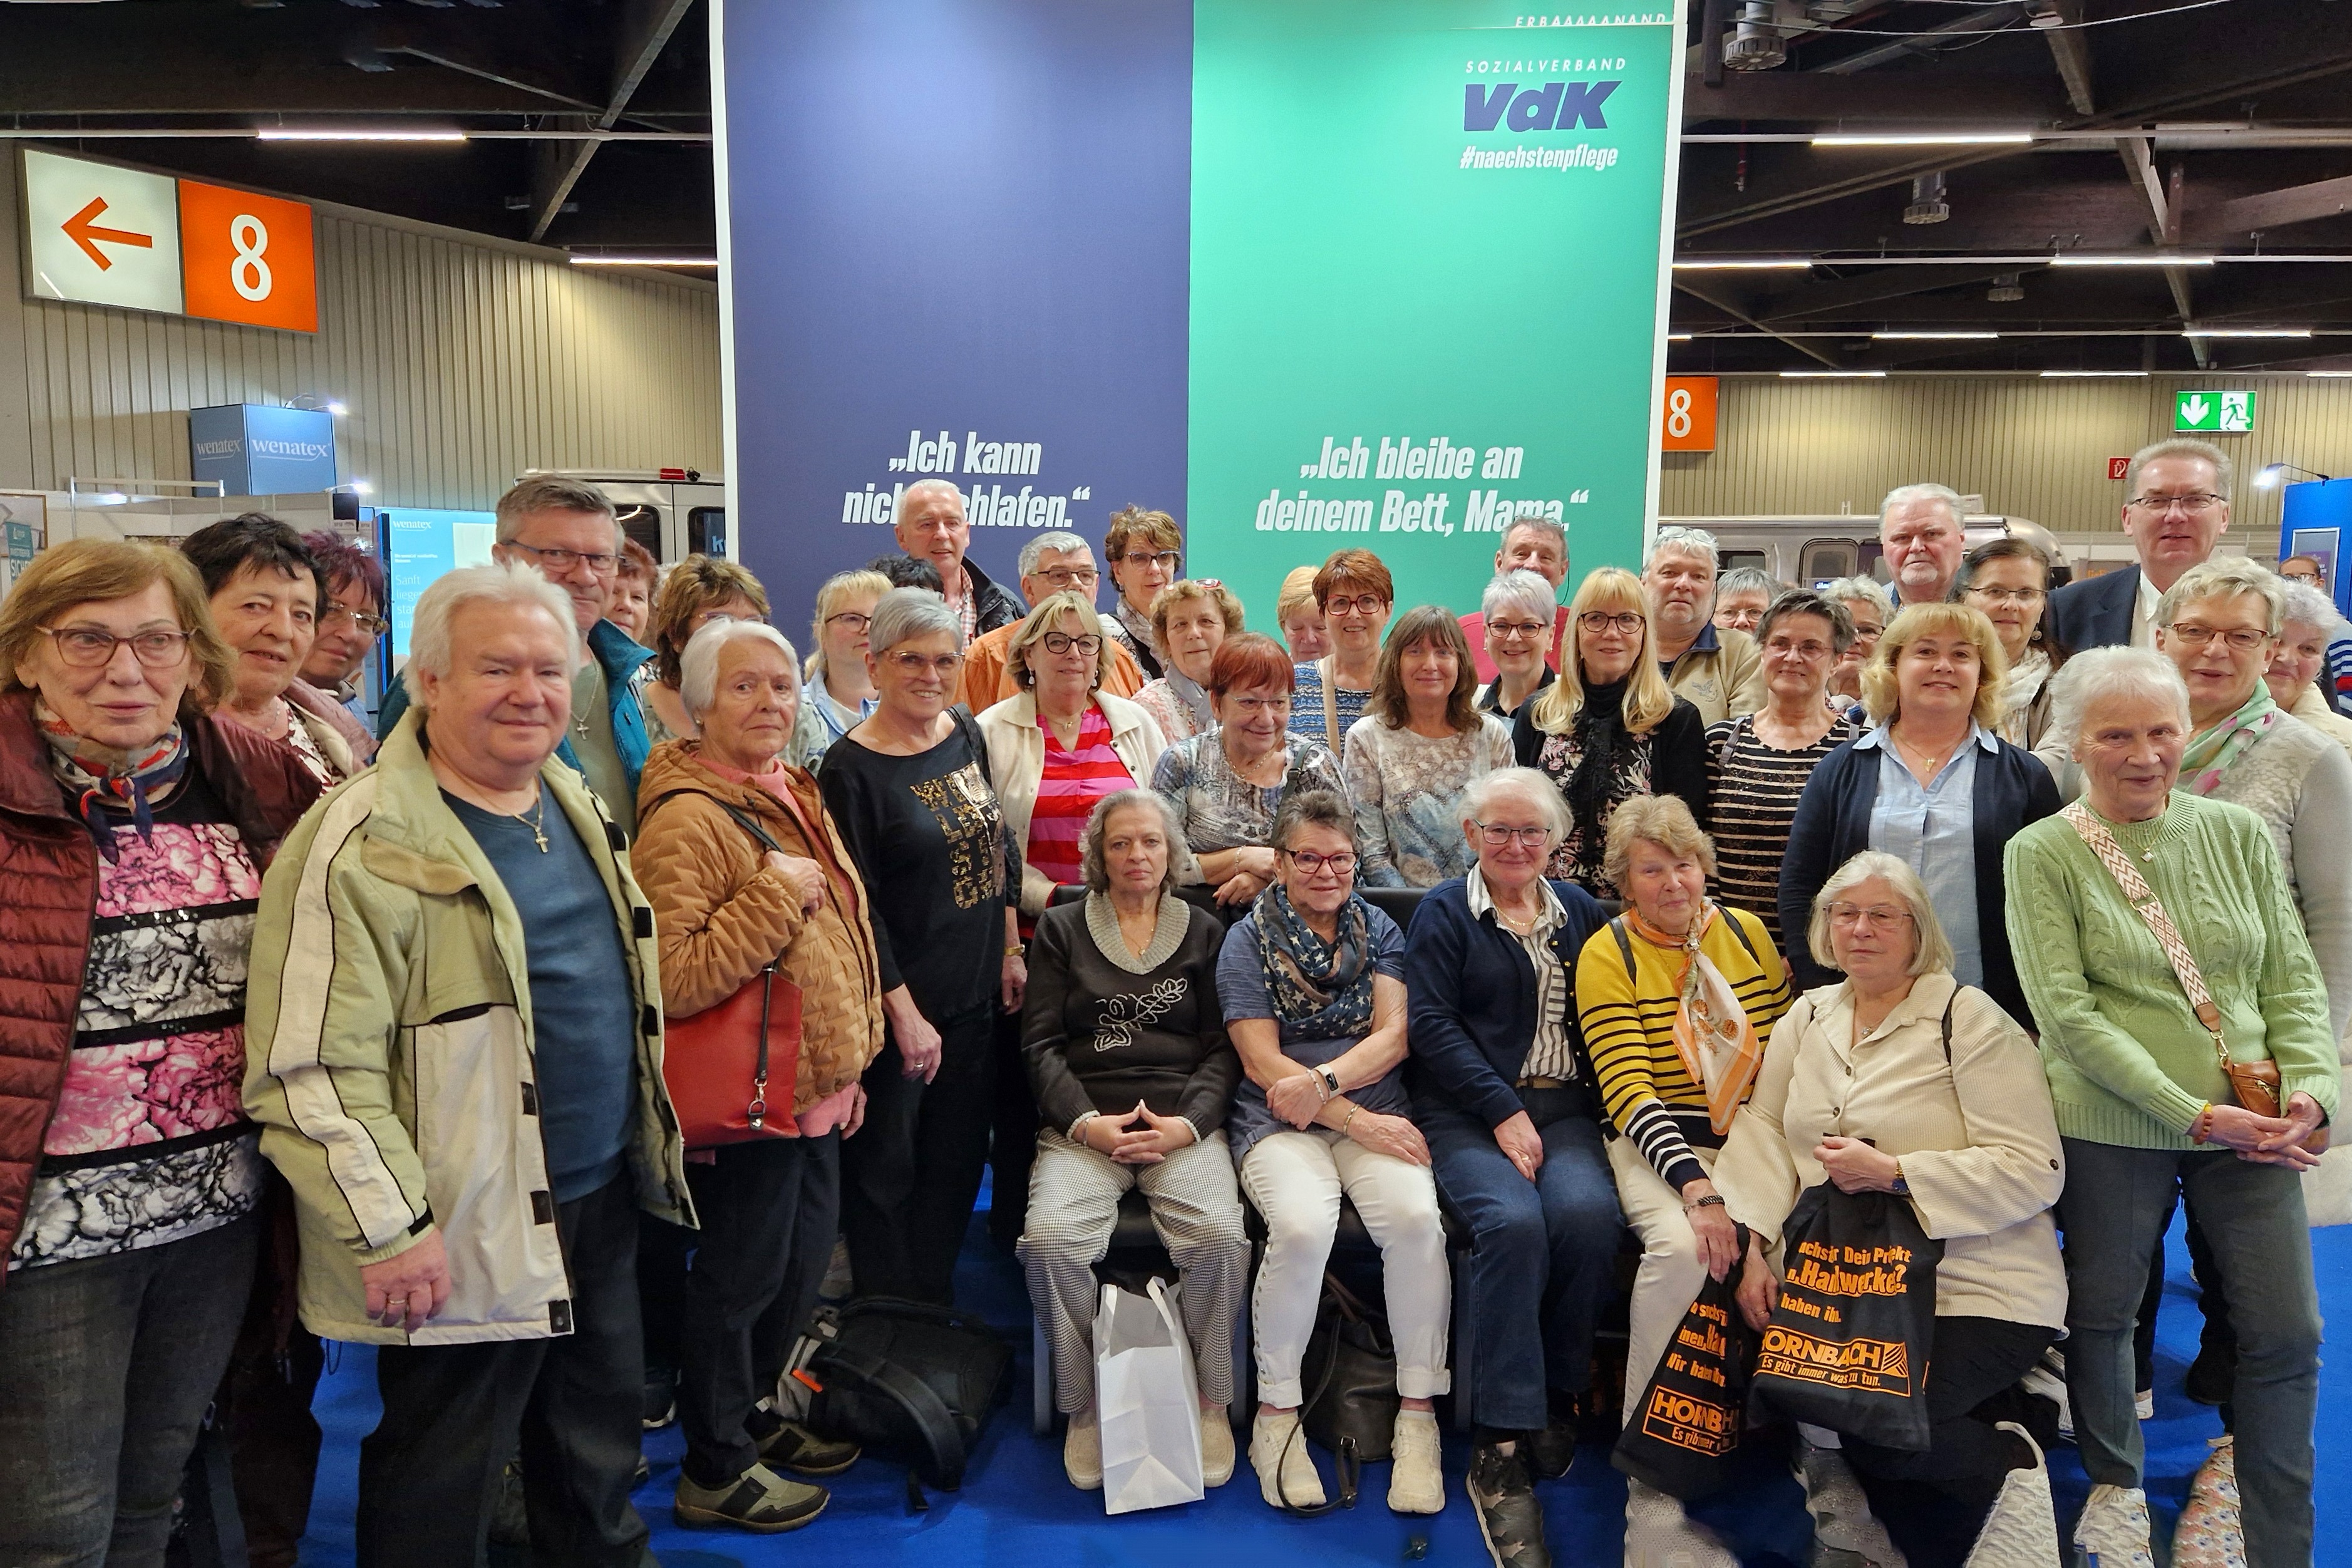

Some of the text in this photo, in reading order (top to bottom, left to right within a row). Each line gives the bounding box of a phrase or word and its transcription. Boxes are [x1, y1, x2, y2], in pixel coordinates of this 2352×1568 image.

[1466, 58, 1626, 74] SOZIALVERBAND
[1464, 81, 1622, 133] VdK
[1460, 144, 1618, 172] #naechstenpflege
[230, 214, 272, 301] 8
[1668, 389, 1691, 438] 8
[197, 438, 241, 460] wenatex
[252, 439, 329, 461] wenatex
[963, 431, 1041, 475] kann
[1375, 436, 1475, 479] bleibe
[1481, 446, 1524, 479] an
[393, 520, 431, 530] wenatex
[1256, 488, 1373, 532] deinem
[1379, 490, 1453, 537] Bett,
[396, 575, 420, 585] Sanft
[1780, 1292, 1821, 1318] haben
[1761, 1330, 1880, 1368] ORNBACH
[1761, 1356, 1773, 1369] Es
[1774, 1360, 1795, 1373] gibt
[1798, 1365, 1828, 1380] immer
[1830, 1371, 1847, 1385] was
[1847, 1372, 1857, 1383] zu
